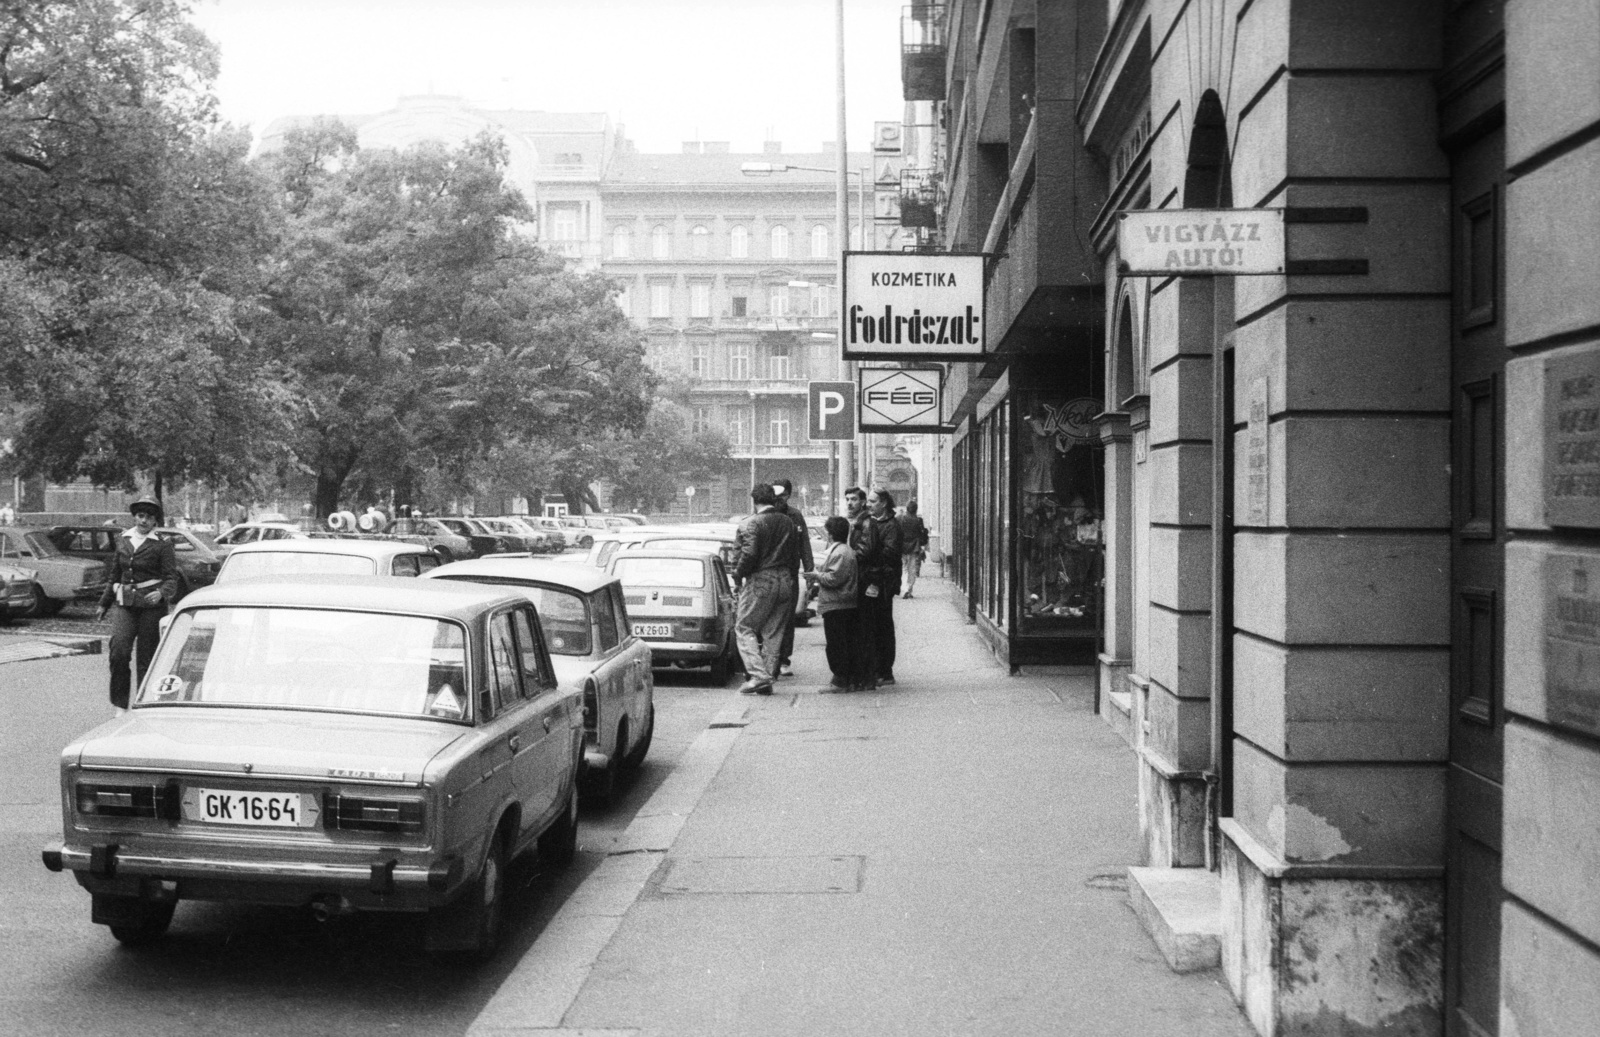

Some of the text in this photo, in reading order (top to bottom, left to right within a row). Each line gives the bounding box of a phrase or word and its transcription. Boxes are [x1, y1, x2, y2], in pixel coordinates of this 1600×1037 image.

[1145, 218, 1261, 243] VIGYÁZZ
[1165, 243, 1243, 267] AUTÓ!
[872, 272, 956, 287] KOZMETIKA
[850, 305, 979, 344] fodrászat
[868, 387, 933, 404] FÉG
[820, 391, 844, 430] P
